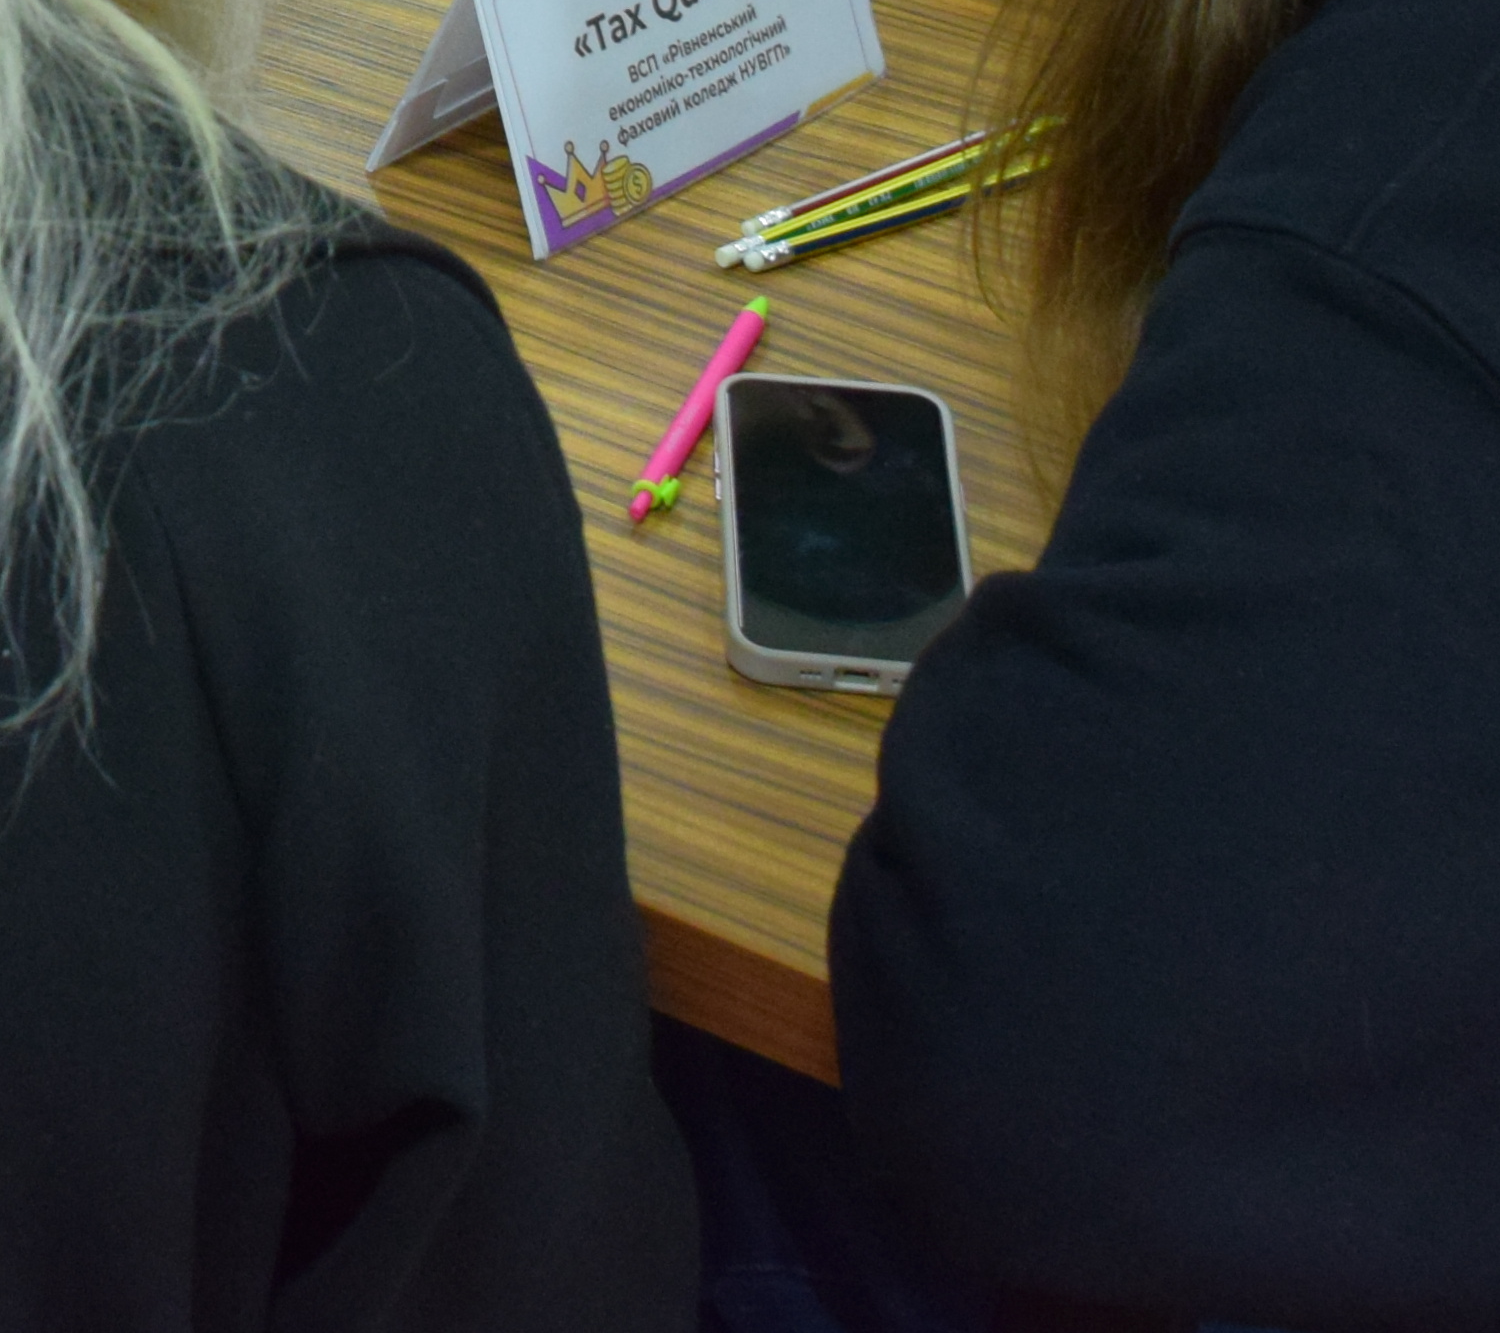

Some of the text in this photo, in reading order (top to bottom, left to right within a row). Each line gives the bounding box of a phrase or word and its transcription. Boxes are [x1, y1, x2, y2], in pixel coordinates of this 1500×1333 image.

[574, 2, 648, 58] «Tax
[608, 14, 788, 121] економіко-технологічний
[627, 3, 758, 83] ВСП «Рівненський
[617, 42, 791, 147] фаховий коледж НУВГП»
